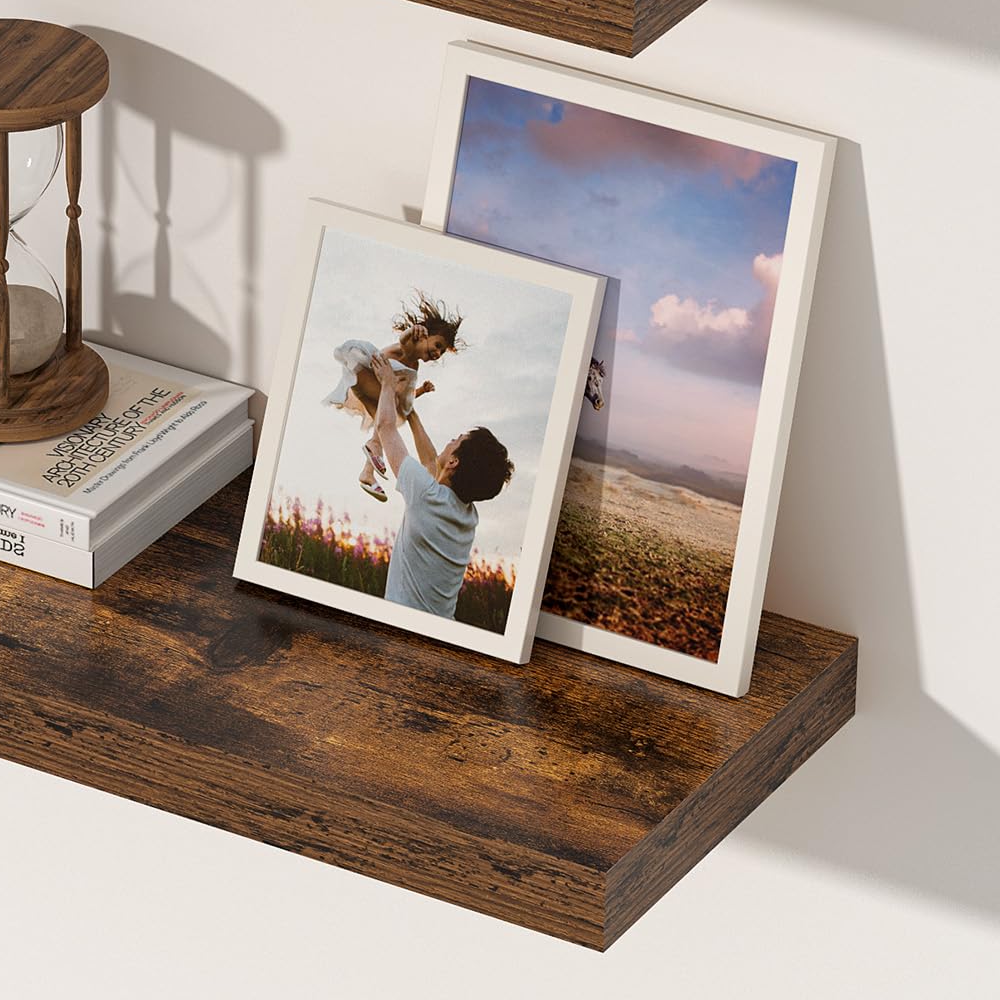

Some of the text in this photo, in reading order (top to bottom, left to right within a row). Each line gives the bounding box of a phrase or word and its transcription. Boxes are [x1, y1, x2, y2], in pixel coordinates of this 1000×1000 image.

[42, 417, 132, 483] ARCHITECTURE
[122, 405, 144, 419] OF
[136, 387, 171, 406] THE
[46, 412, 112, 457] VISIONARY
[57, 421, 147, 488] 20TH CENTURY
